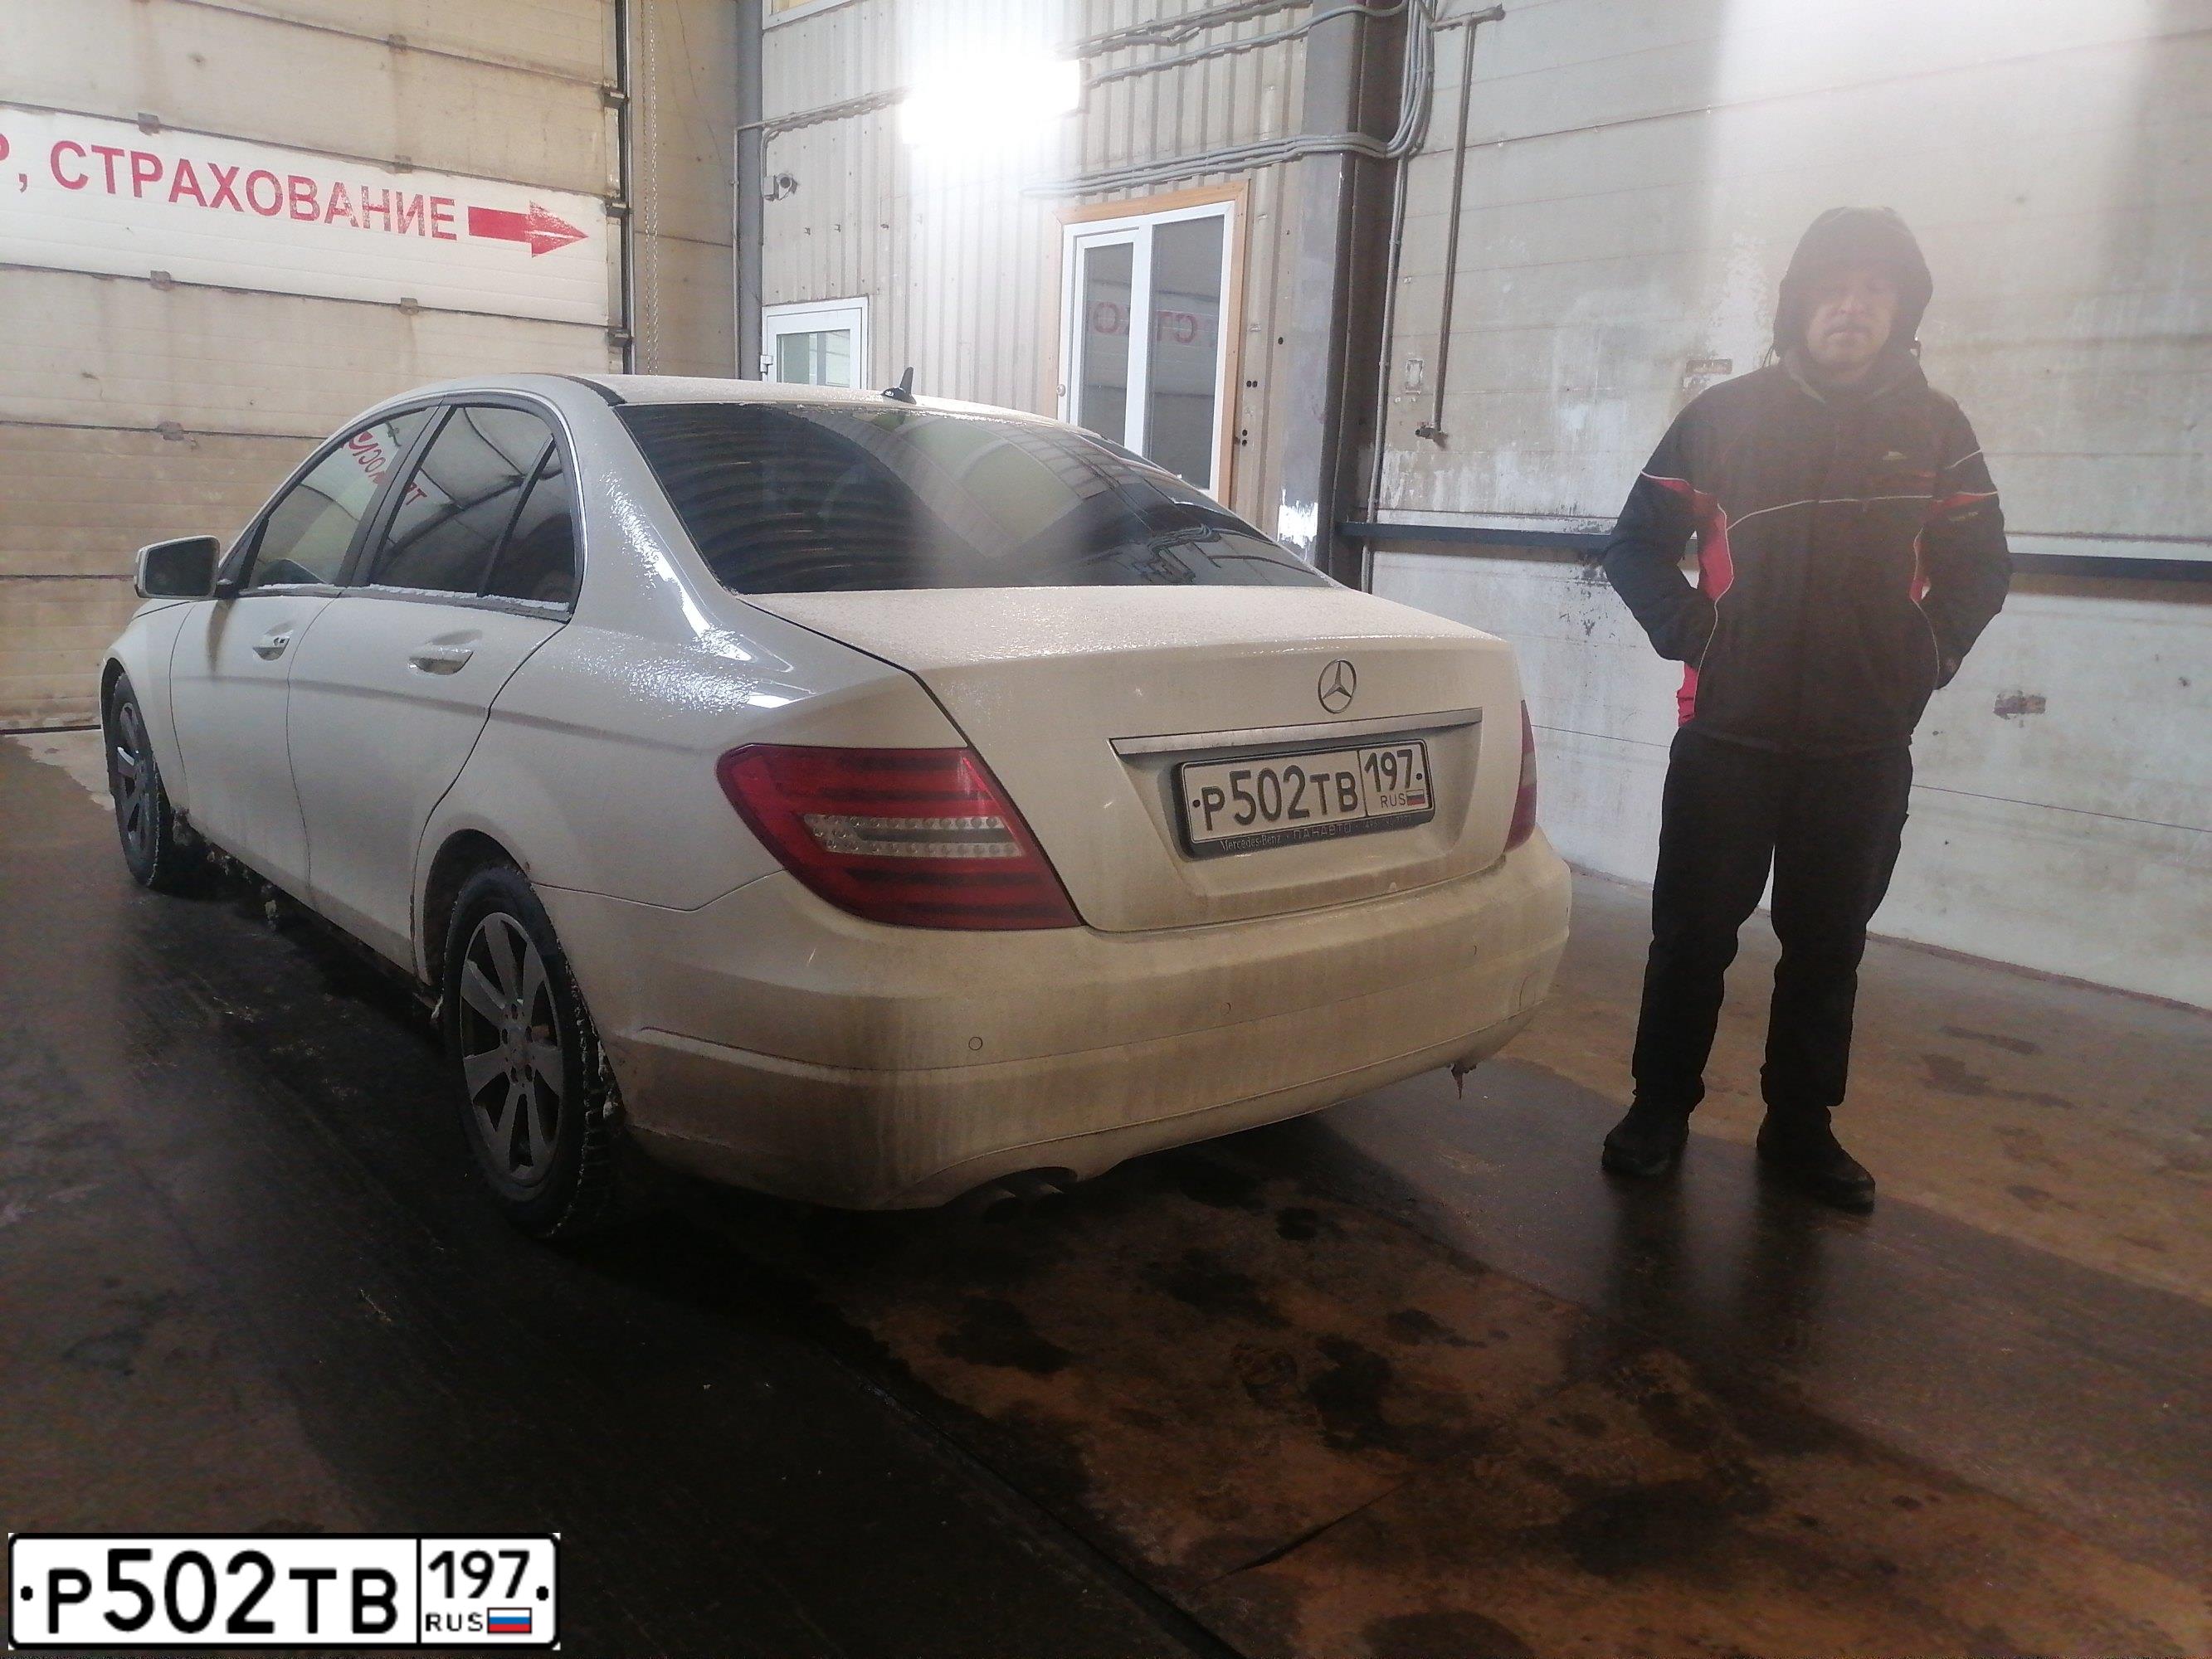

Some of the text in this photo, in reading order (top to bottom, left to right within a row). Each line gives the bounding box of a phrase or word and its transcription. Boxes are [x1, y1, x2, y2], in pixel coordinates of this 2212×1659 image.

[51, 140, 457, 241] СТРАХОВАНИЕ
[1364, 749, 1413, 792] 197
[1381, 791, 1406, 808] RUS
